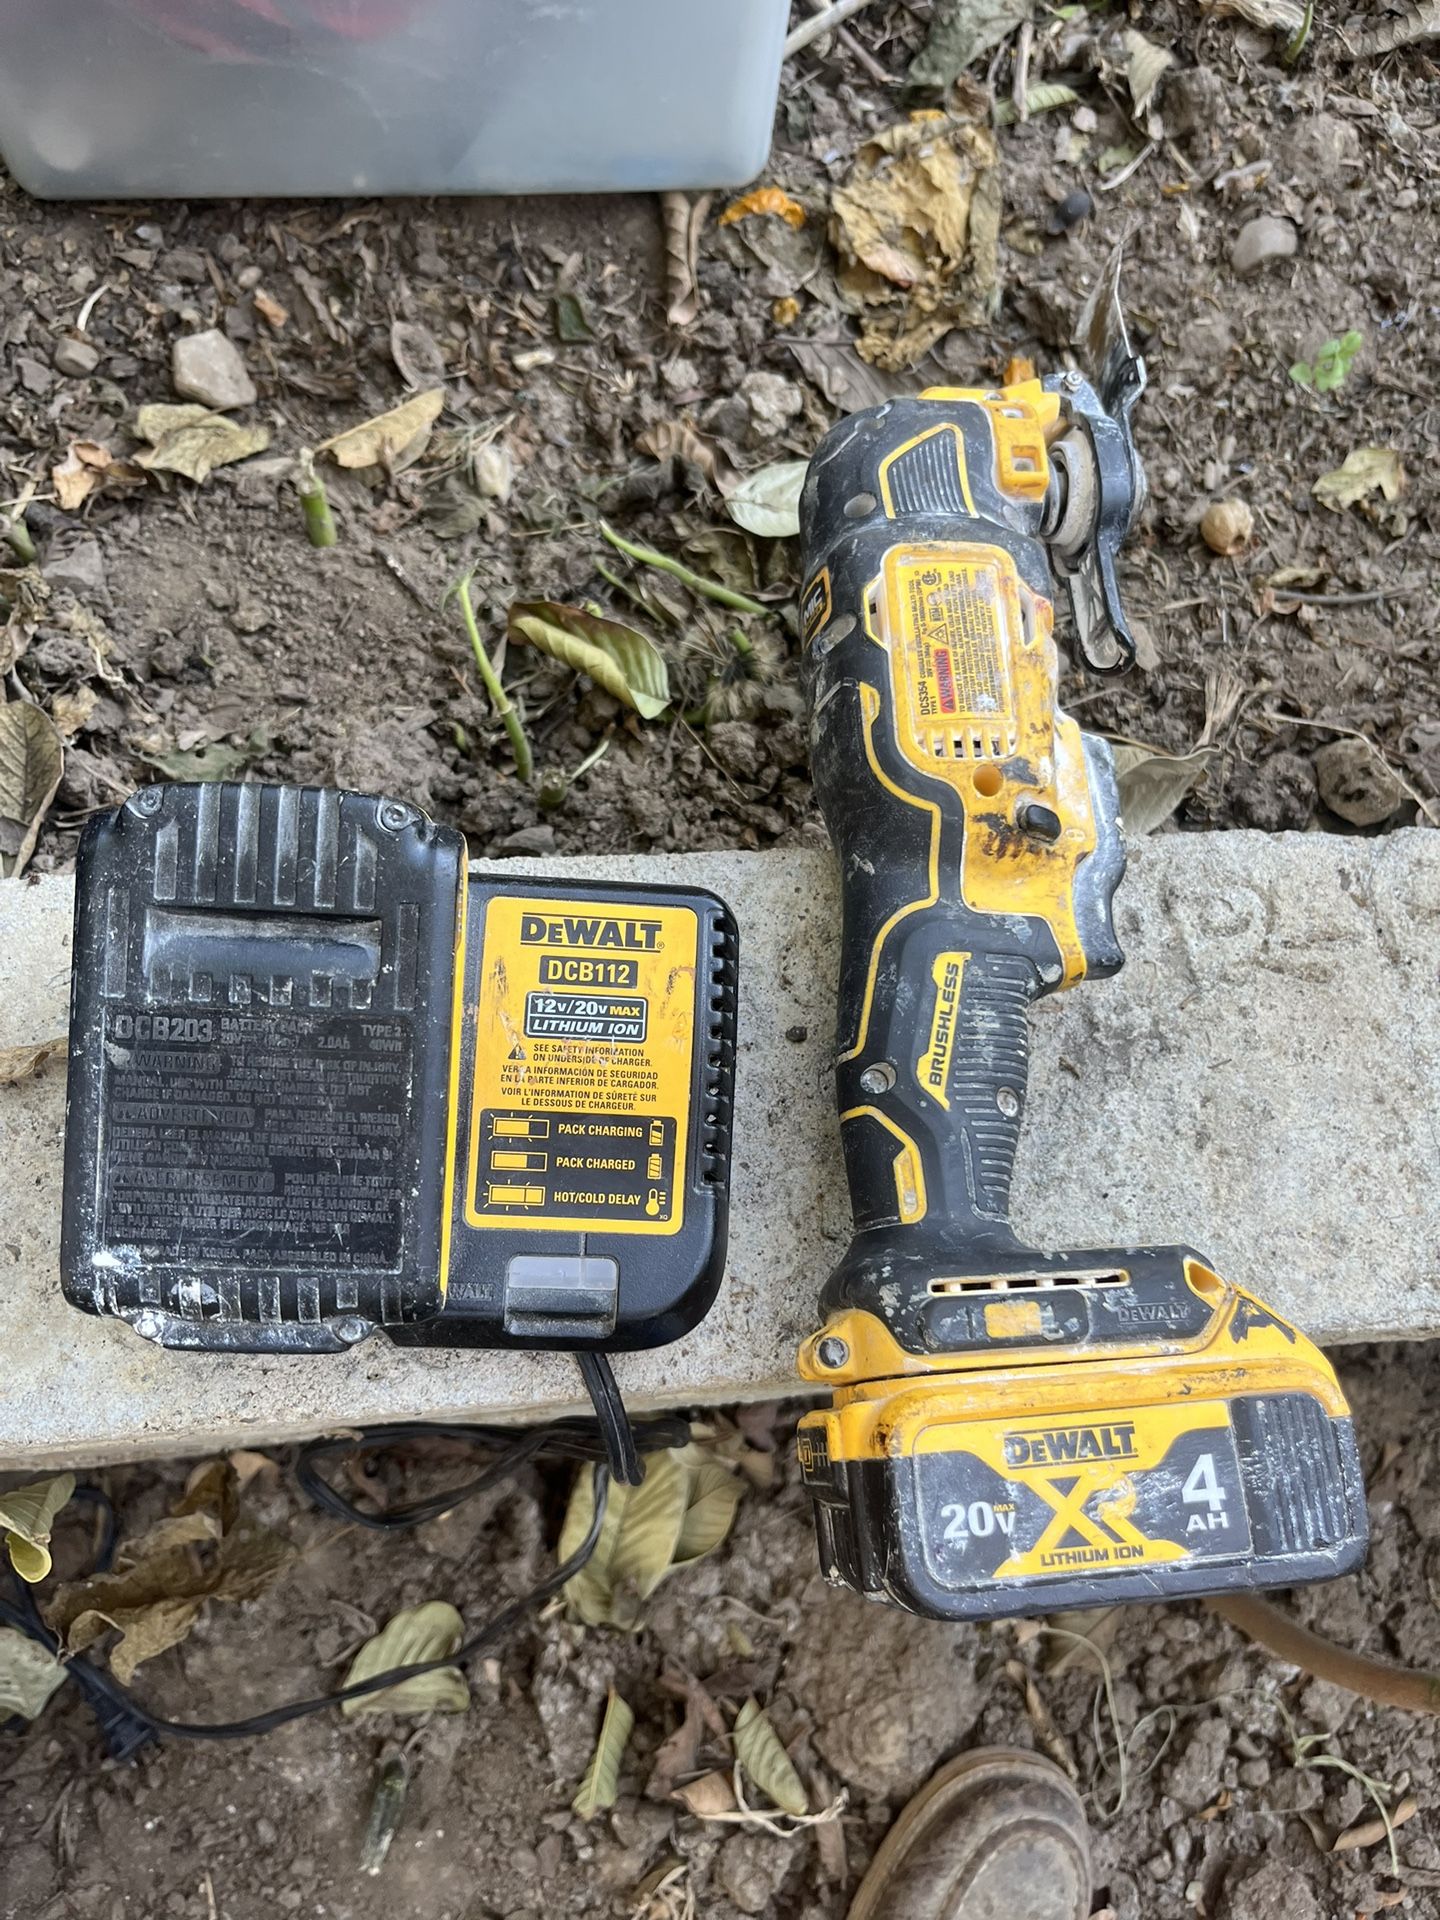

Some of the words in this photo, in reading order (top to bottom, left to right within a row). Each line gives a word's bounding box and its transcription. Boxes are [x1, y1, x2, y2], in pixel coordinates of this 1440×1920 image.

[935, 650, 951, 699] WARNING
[917, 681, 931, 715] DCS354
[548, 959, 630, 984] DCB112
[609, 1006, 641, 1016] MAX
[115, 1014, 213, 1043] DCB203
[360, 1024, 392, 1038] TYPE
[533, 1019, 604, 1034] LITHIUM
[607, 1022, 640, 1036] ION
[929, 962, 960, 1087] BRUSHLESS
[533, 1044, 549, 1053] SEE
[533, 1053, 546, 1062] ON
[534, 1065, 594, 1077] INFORMACIÓN
[597, 1069, 608, 1078] DE
[610, 1070, 659, 1080] SEGURIDAD
[500, 1075, 513, 1083] EN
[556, 1077, 595, 1087] INFERIOR
[597, 1079, 608, 1087] DE
[610, 1079, 659, 1090] CARGADOR.
[501, 1087, 522, 1096] VOIR
[524, 1088, 591, 1100] L'INFORMATION
[593, 1091, 604, 1100] DE
[606, 1090, 638, 1102] SÛRETÉ
[640, 1093, 657, 1102] SUR
[521, 1097, 532, 1106] LE
[533, 1098, 573, 1108] DESSOUS
[575, 1100, 587, 1109] DE
[588, 1100, 636, 1111] CHARGEUR.
[558, 1123, 586, 1135] PACK
[588, 1124, 643, 1138] CHARGING
[556, 1157, 584, 1168] PACK
[586, 1158, 636, 1171] CHARGED
[554, 1191, 606, 1205] HOT/COLD
[608, 1193, 641, 1205] DELAY
[1181, 1453, 1226, 1512] 4
[940, 1500, 1016, 1540] 20V
[1186, 1512, 1230, 1533] AH
[1040, 1548, 1109, 1567] LITHIUM
[1113, 1544, 1145, 1560] ION
